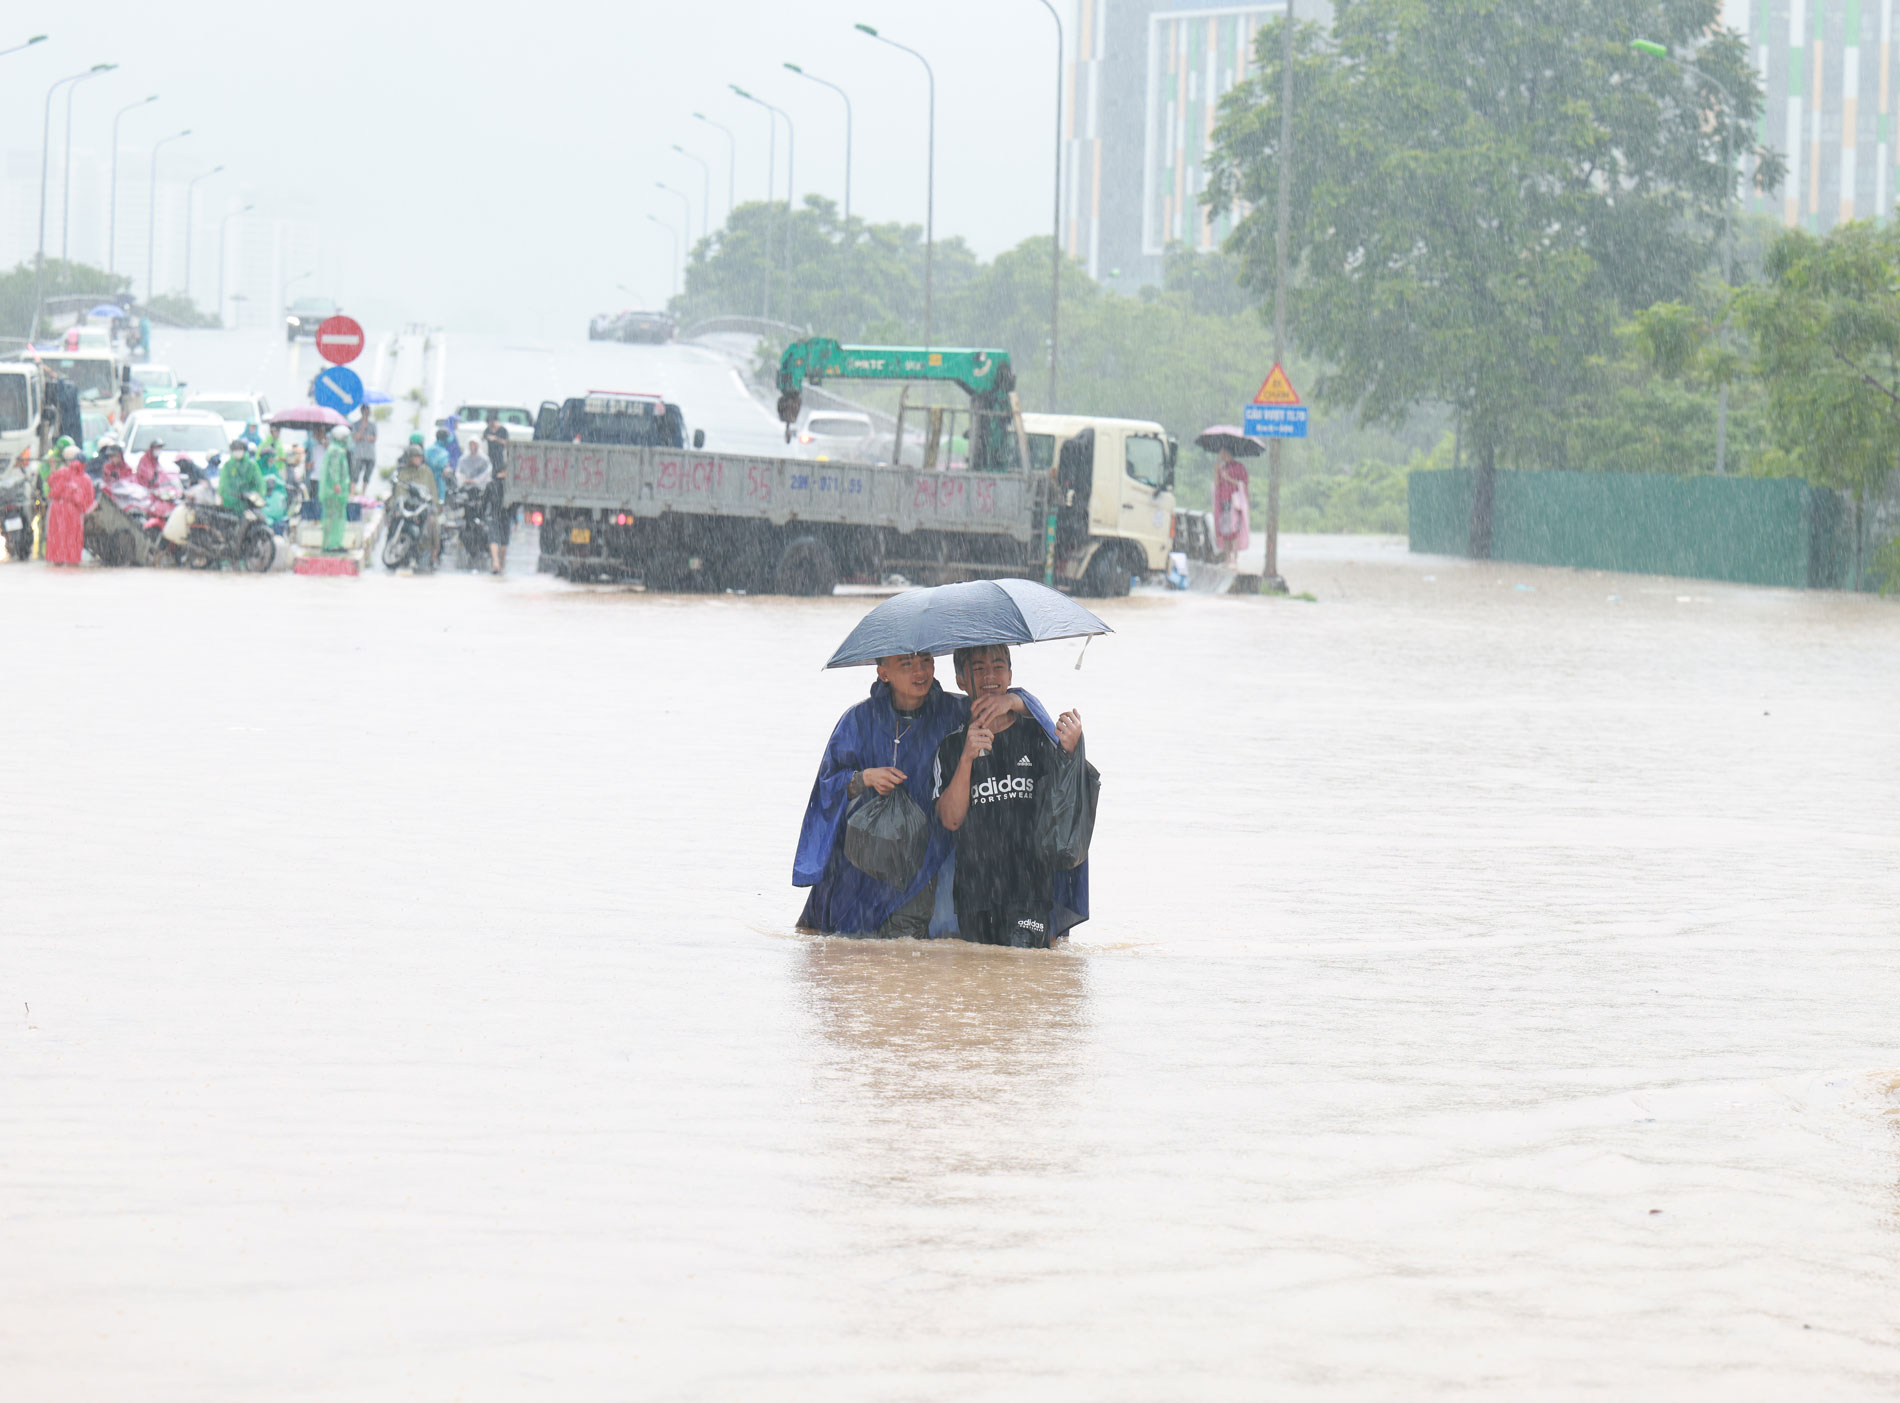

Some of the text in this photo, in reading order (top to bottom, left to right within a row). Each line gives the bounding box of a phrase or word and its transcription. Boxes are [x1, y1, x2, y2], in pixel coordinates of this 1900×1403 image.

[971, 774, 1034, 799] adidas
[972, 791, 1033, 805] PORTSWEAR
[1017, 918, 1044, 930] adidas
